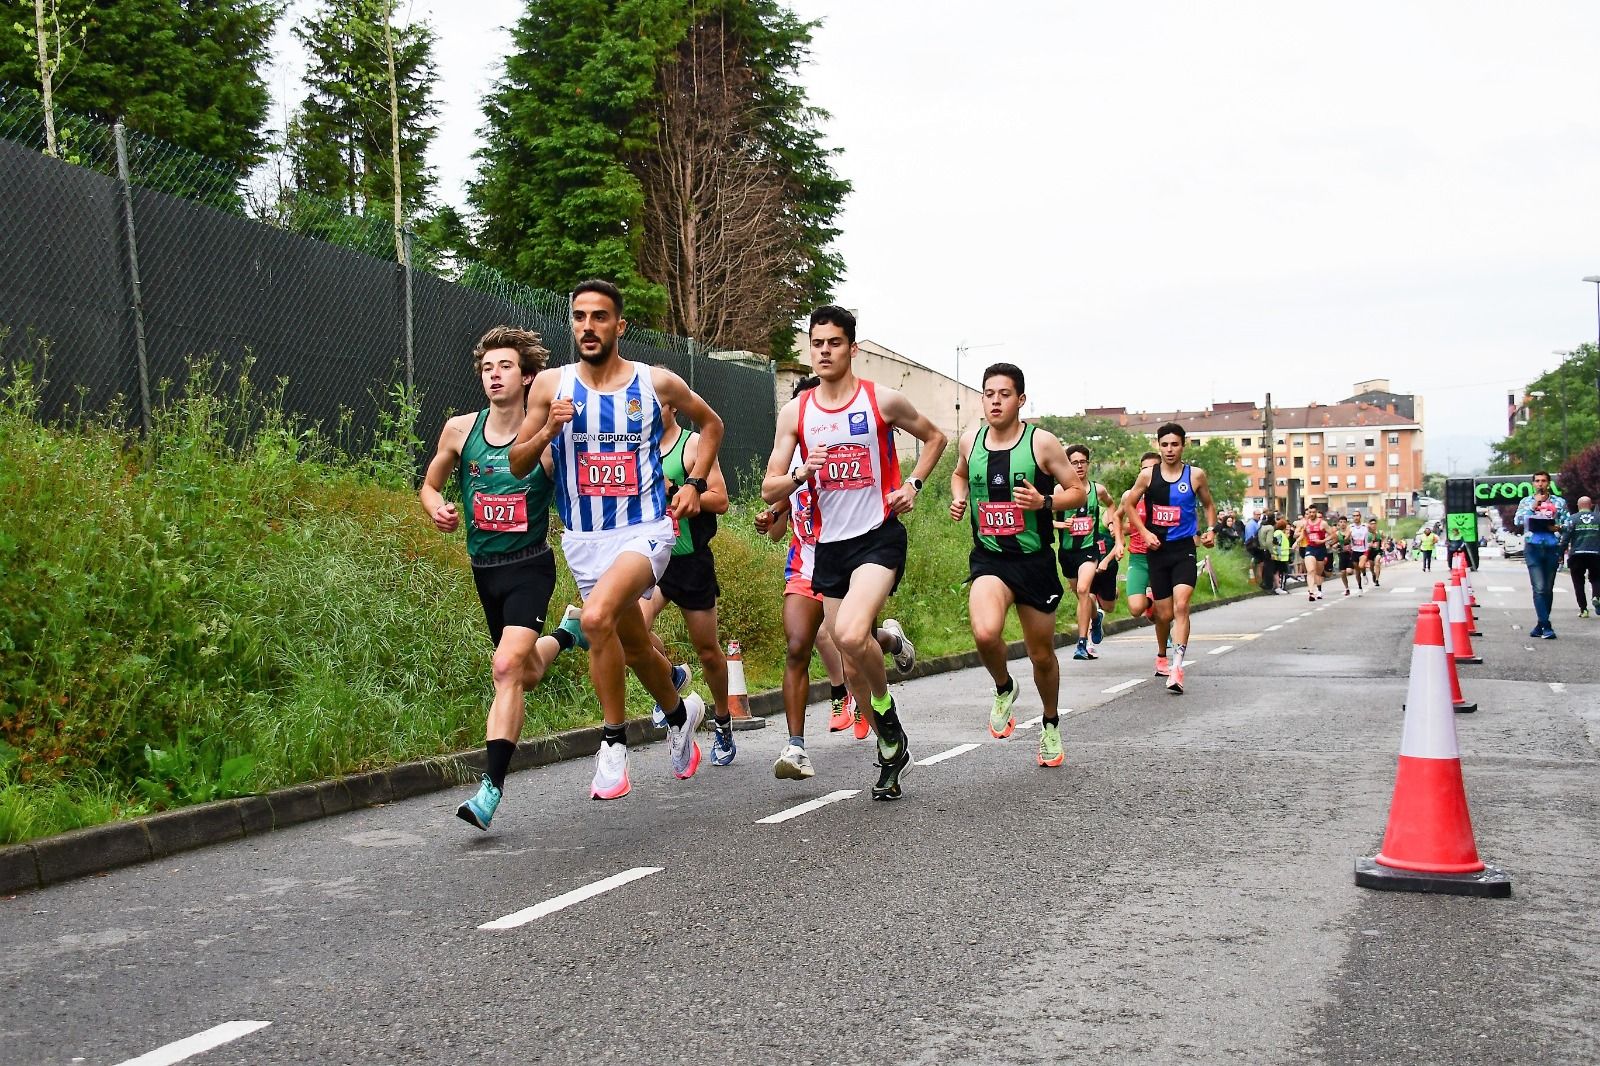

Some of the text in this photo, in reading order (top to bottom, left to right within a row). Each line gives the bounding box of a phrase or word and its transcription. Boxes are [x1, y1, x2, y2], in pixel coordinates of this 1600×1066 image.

[597, 433, 642, 442] GIPUZKOA
[589, 465, 626, 484] 029
[828, 460, 862, 480] 022
[483, 505, 516, 521] 027
[985, 511, 1015, 527] 036
[1156, 511, 1174, 522] 037
[1073, 521, 1090, 531] 035
